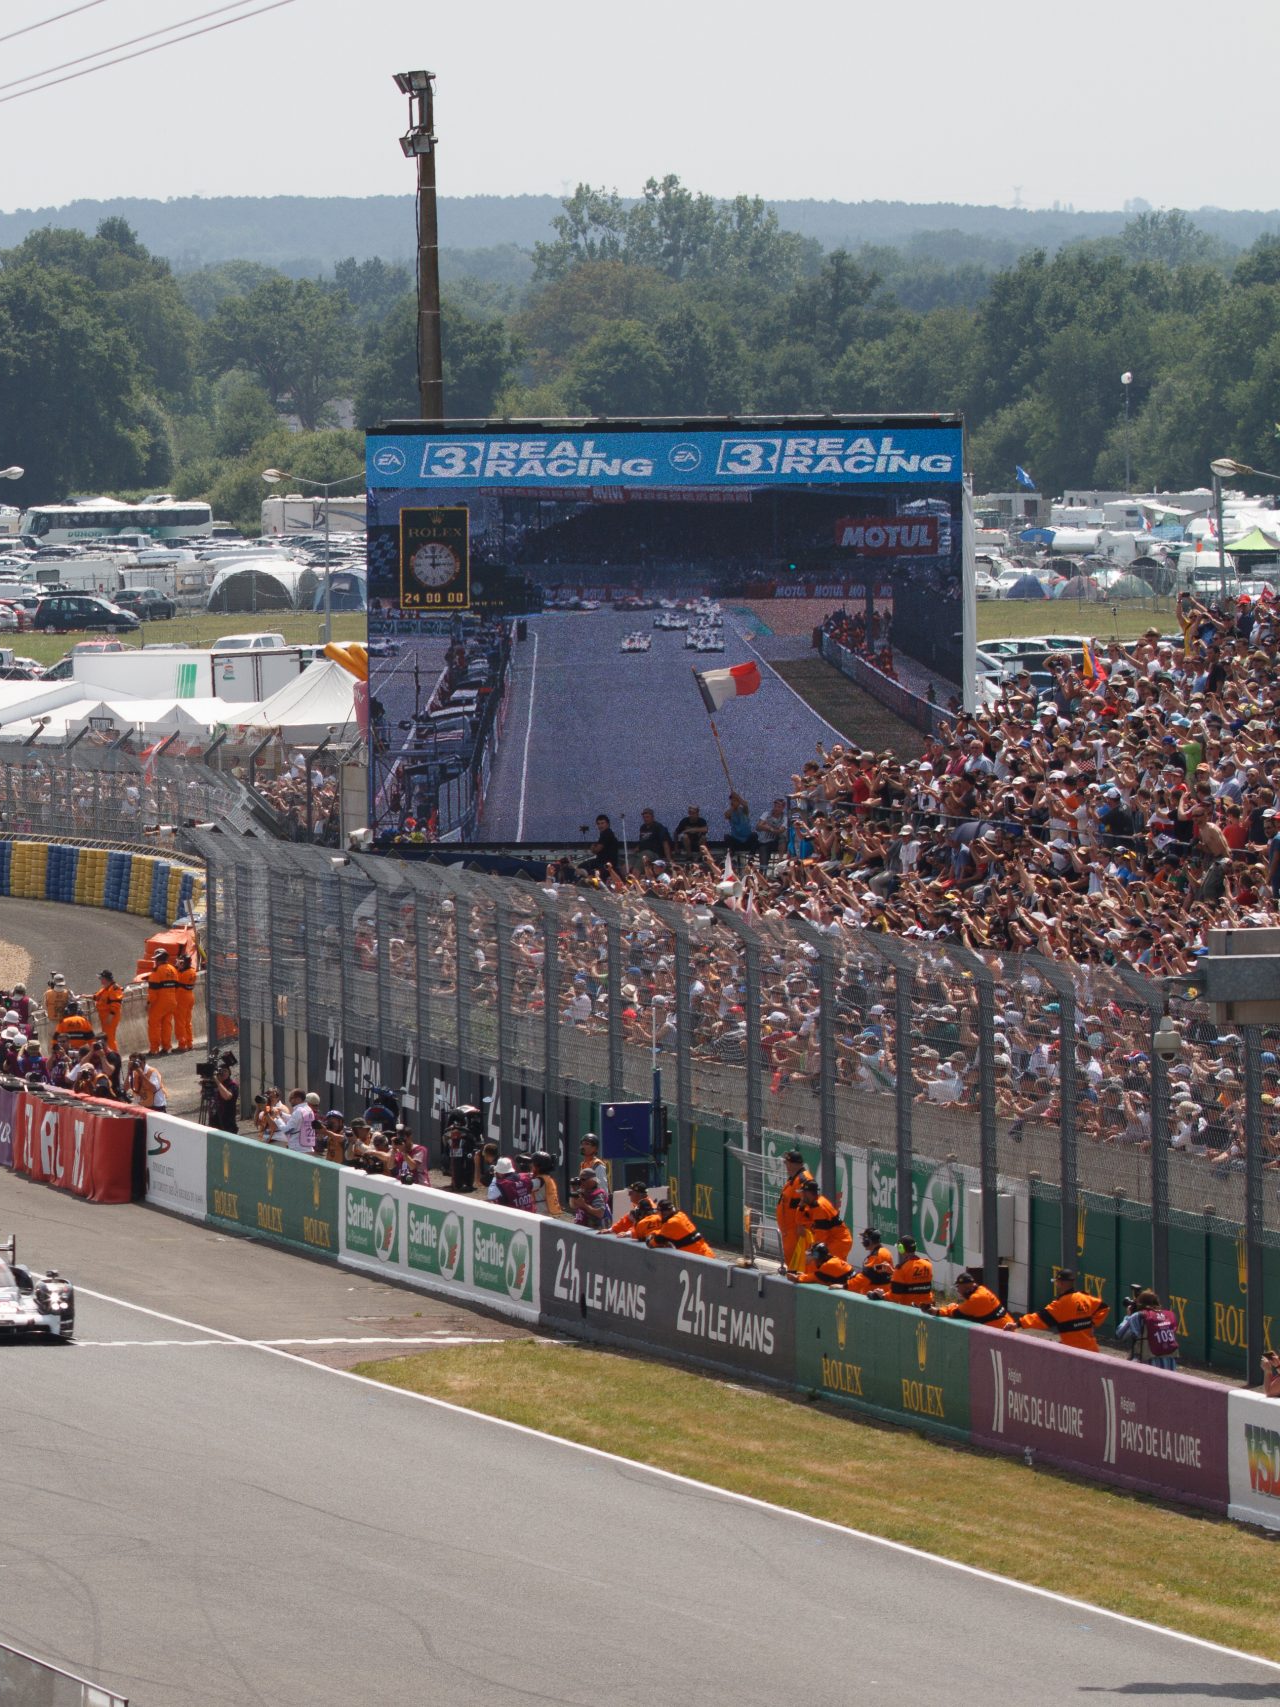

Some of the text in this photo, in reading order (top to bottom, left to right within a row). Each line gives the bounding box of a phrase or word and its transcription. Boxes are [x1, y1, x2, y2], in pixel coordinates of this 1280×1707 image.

[488, 440, 607, 459] REAL
[780, 454, 953, 473] RACING
[784, 437, 905, 455] REAL
[483, 458, 654, 477] RACING
[408, 528, 462, 538] ROLEX
[840, 525, 932, 547] MOTUL
[404, 592, 463, 604] 24 00 00
[214, 1189, 240, 1220] ROLEX
[257, 1202, 283, 1233] ROLEX
[347, 1192, 374, 1231] Sarthe
[303, 1216, 330, 1248] ROLEX
[409, 1209, 437, 1249] Sarthe
[474, 1228, 504, 1268] Sarthe
[554, 1238, 646, 1321] 24h LE MANS
[676, 1269, 775, 1355] 24h LE MANS
[1214, 1302, 1273, 1351] ROLX
[822, 1357, 864, 1396] ROLEX
[901, 1378, 945, 1418] ROLEX
[1008, 1390, 1084, 1439] PAYS DE LA LOIRE
[1120, 1419, 1202, 1469] PAYS DE LA LOIRE
